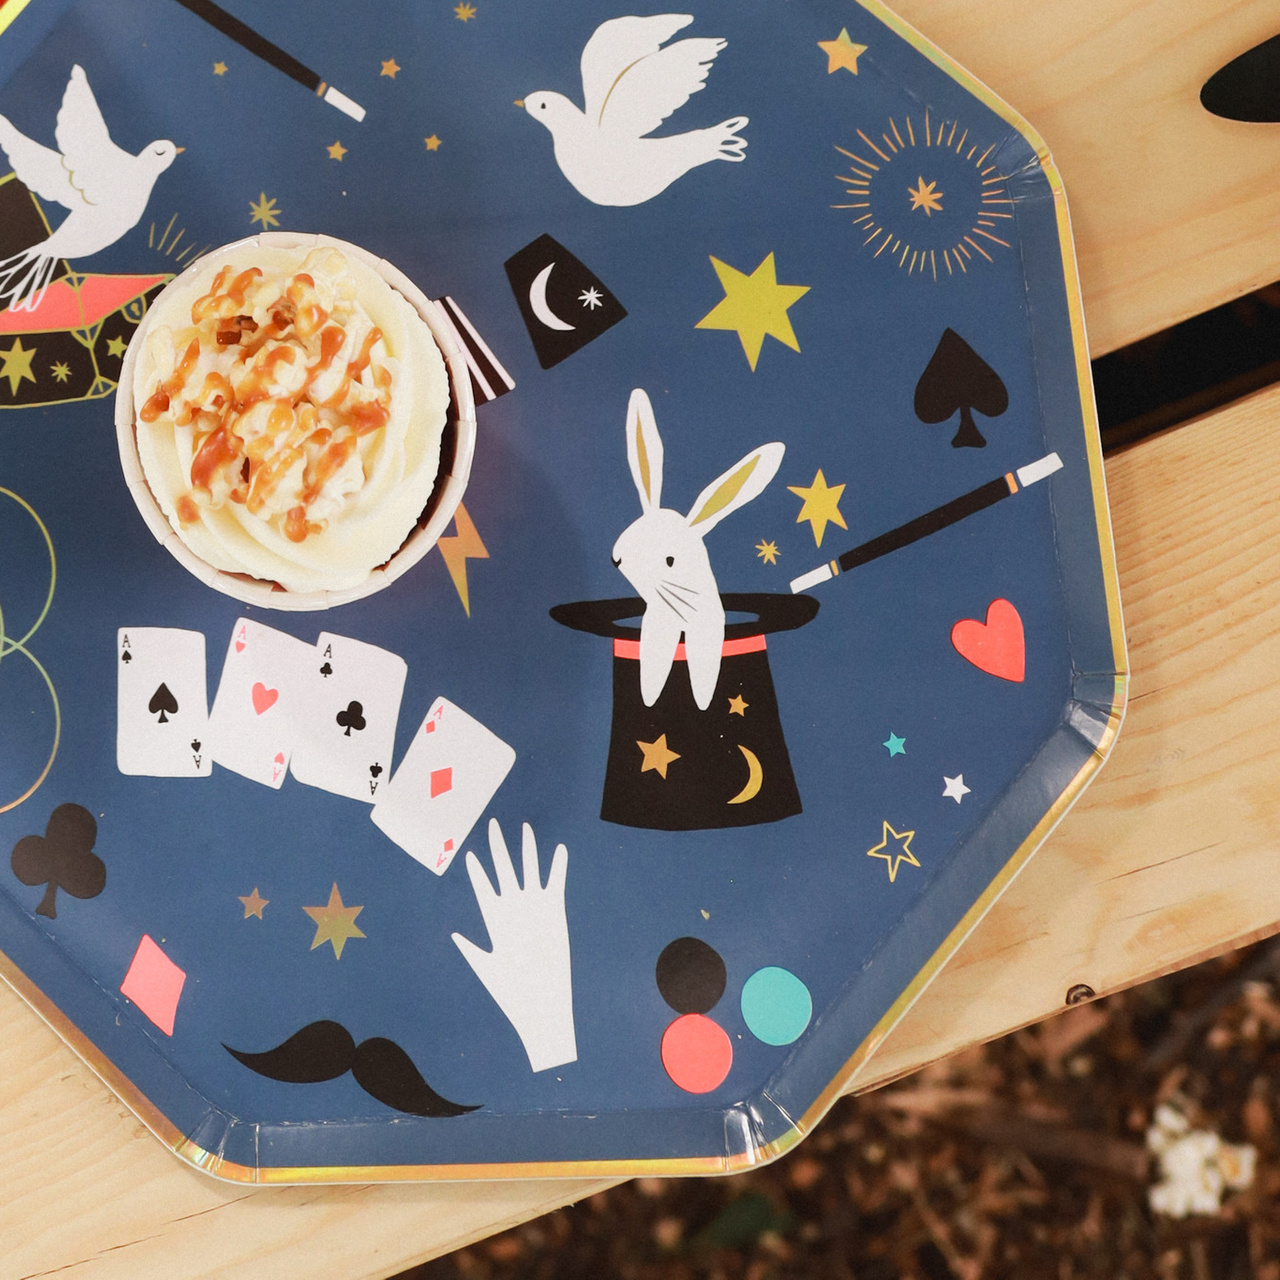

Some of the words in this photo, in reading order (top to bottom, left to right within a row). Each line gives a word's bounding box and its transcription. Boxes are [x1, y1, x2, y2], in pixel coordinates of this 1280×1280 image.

[122, 633, 131, 648] A
[237, 625, 247, 640] A
[323, 643, 333, 659] A
[433, 704, 444, 720] A
[192, 754, 202, 770] A
[272, 767, 282, 782] A
[369, 780, 379, 796] A
